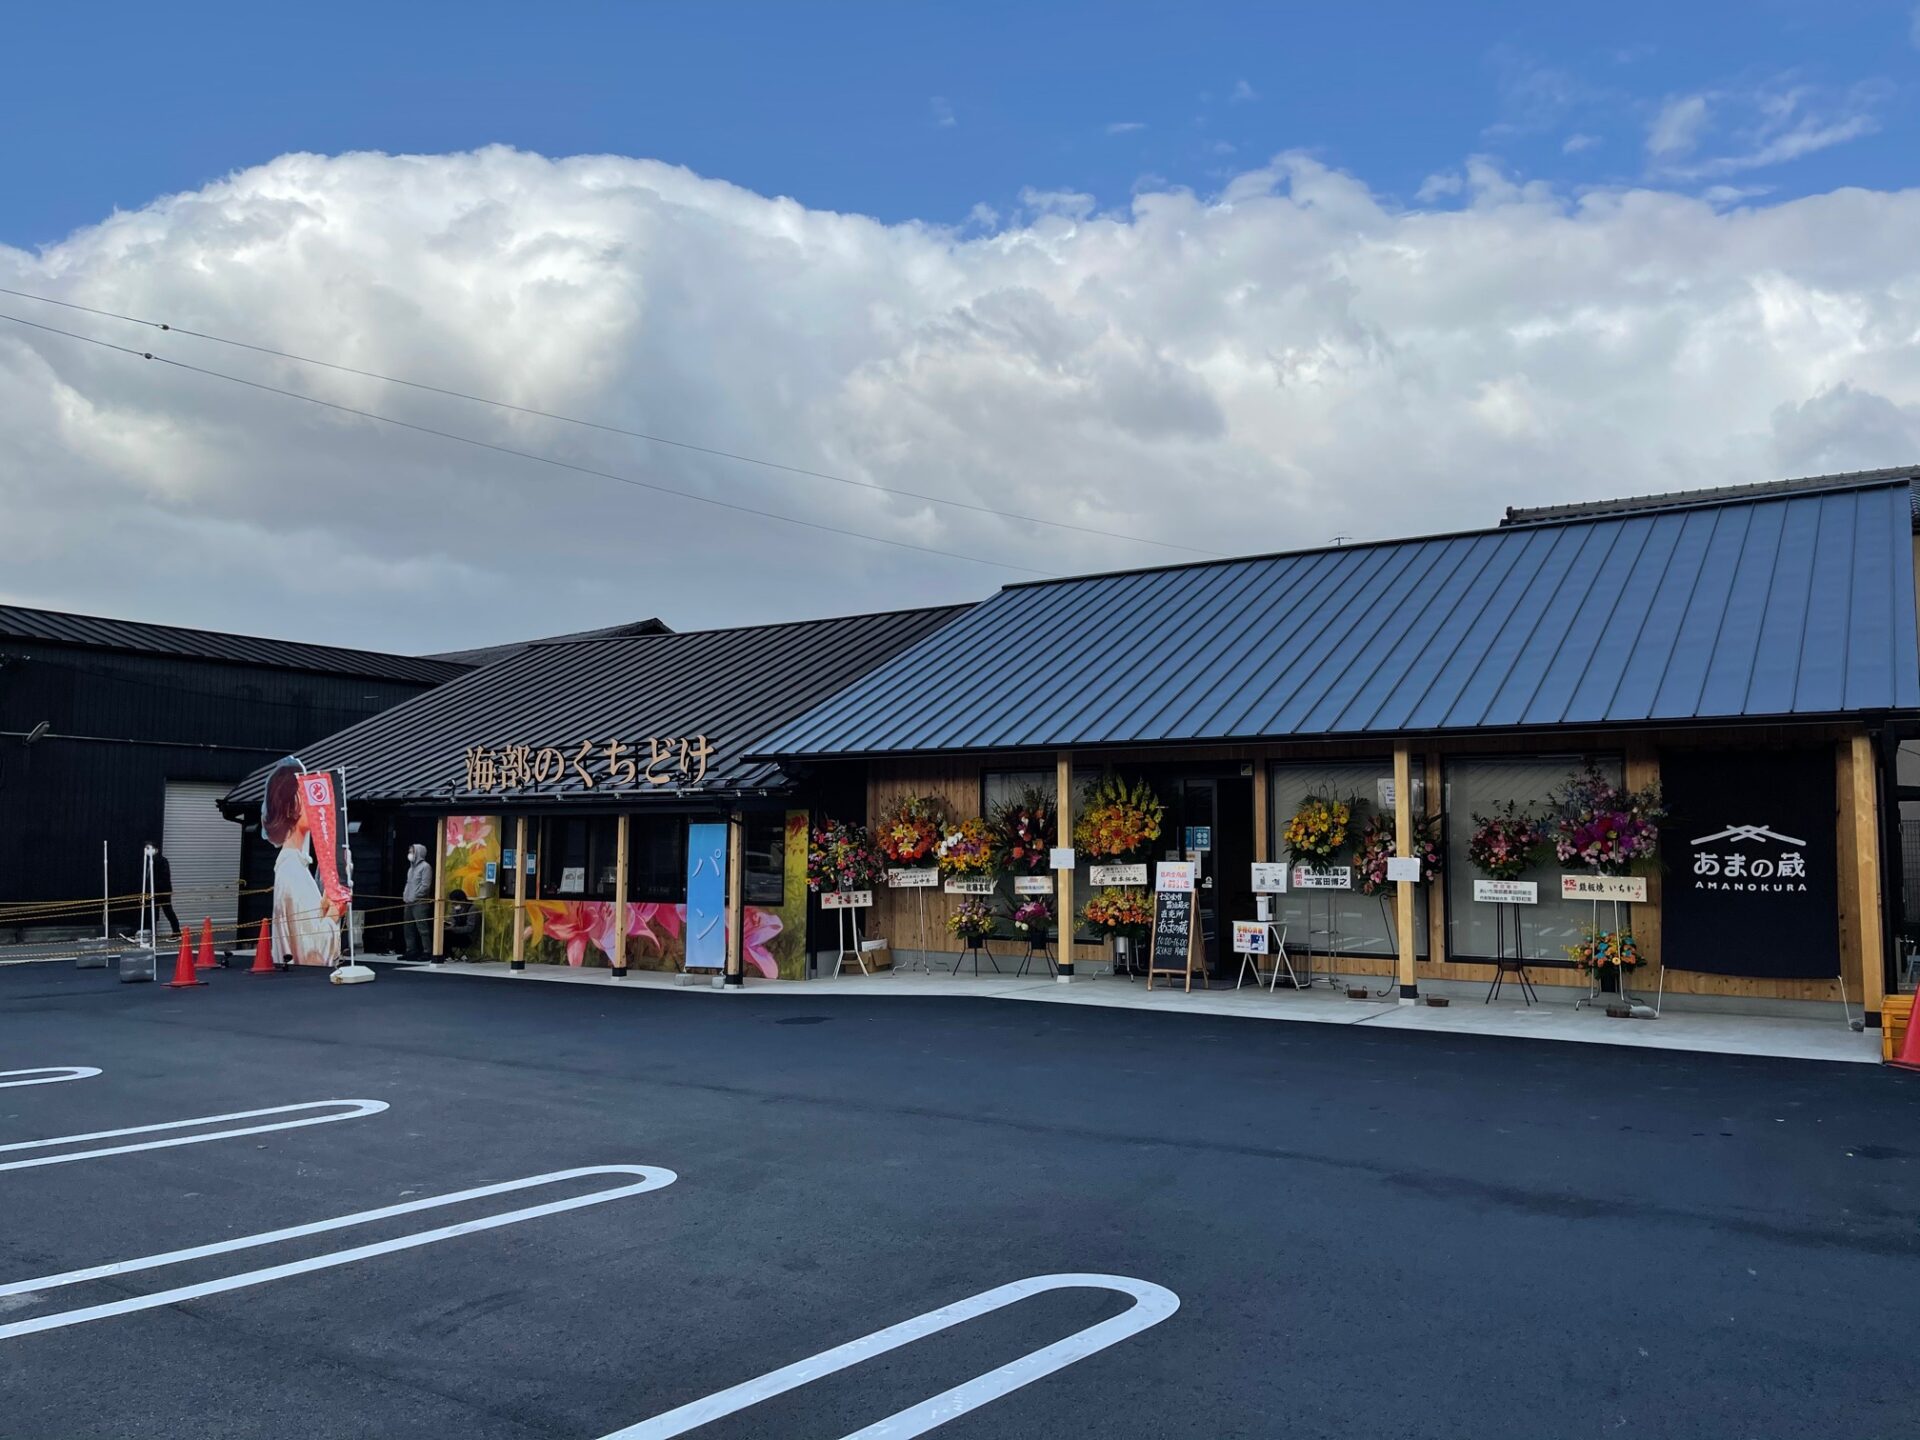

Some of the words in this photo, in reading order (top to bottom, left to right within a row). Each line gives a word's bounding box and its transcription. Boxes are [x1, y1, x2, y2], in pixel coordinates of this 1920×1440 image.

[465, 735, 714, 791] 海部のくちどけ
[1693, 852, 1806, 878] あまの蔵
[692, 848, 721, 940] パン
[1695, 881, 1807, 892] AMANOKURA
[1157, 918, 1189, 935] あまの蔵
